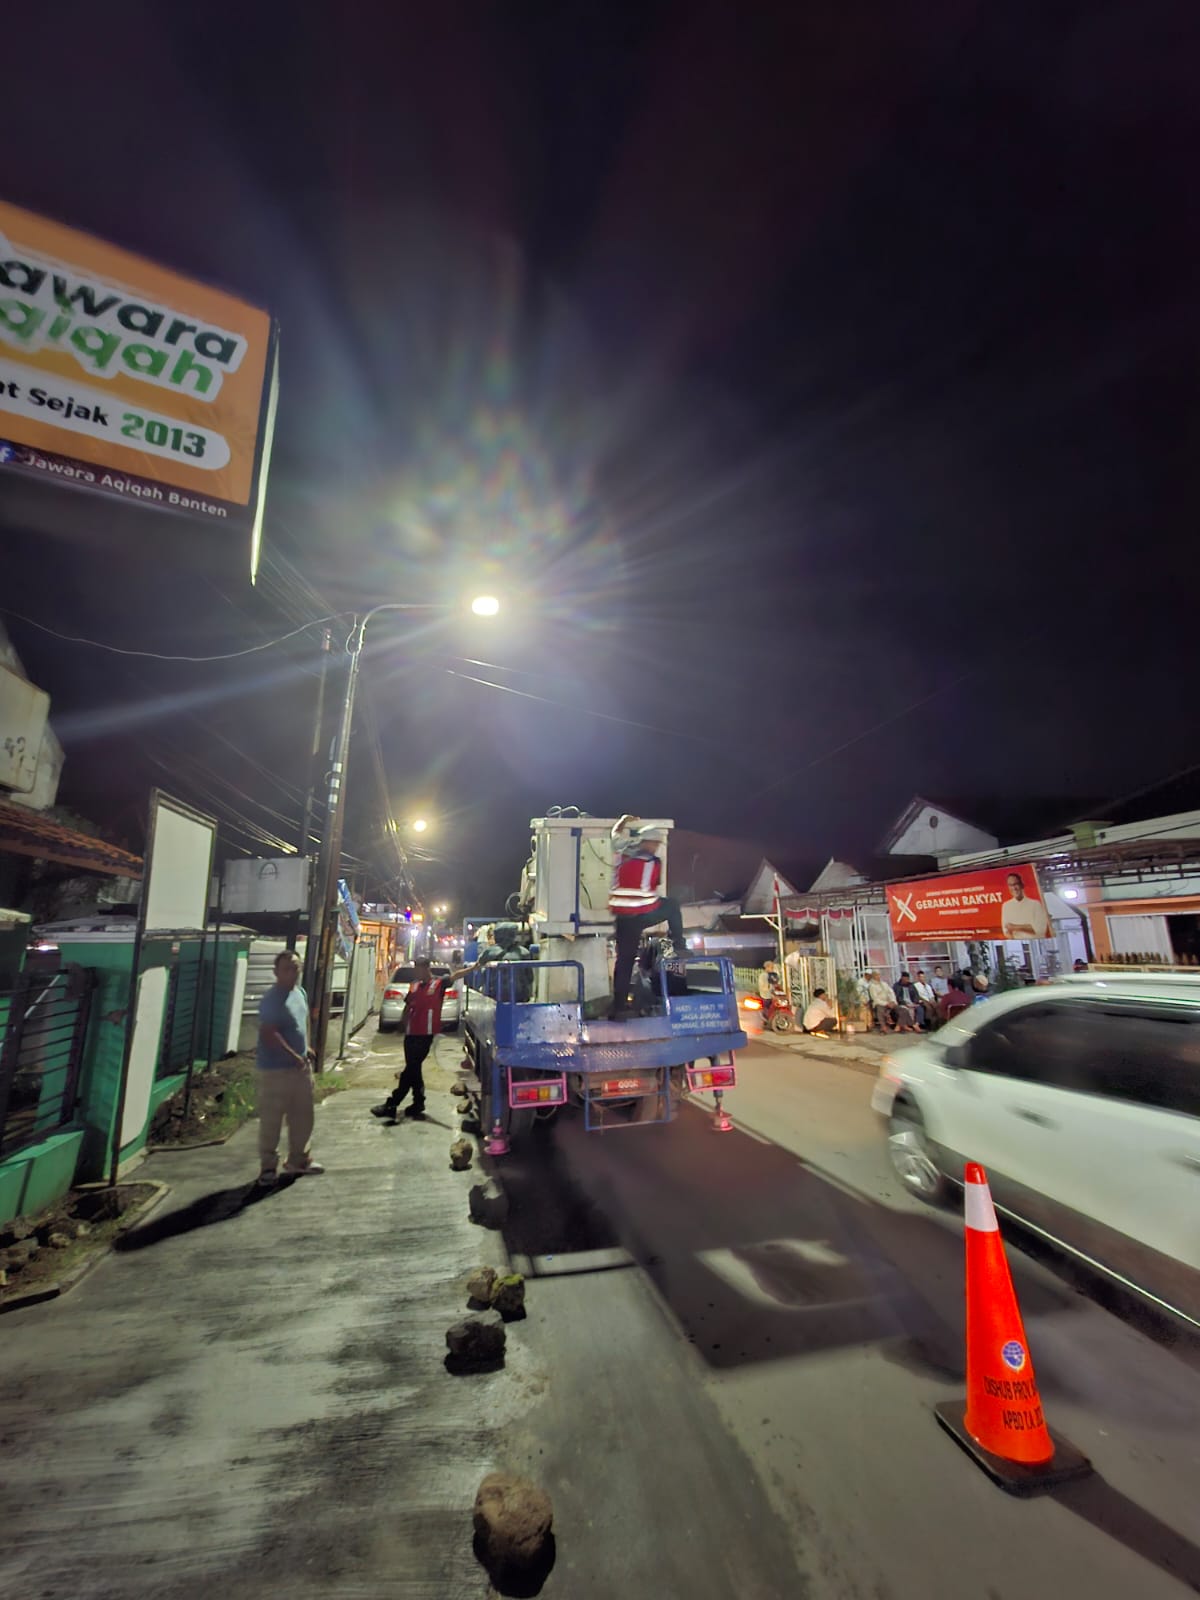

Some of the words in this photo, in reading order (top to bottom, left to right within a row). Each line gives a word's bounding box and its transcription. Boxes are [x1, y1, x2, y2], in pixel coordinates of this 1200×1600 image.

[28, 388, 108, 426] Sejak
[121, 412, 207, 458] 2013
[24, 455, 96, 482] Jawara
[101, 474, 163, 500] Aqiqah
[168, 492, 227, 517] Banten
[916, 897, 960, 910] GERAKAN
[961, 892, 1003, 906] RAKYAT
